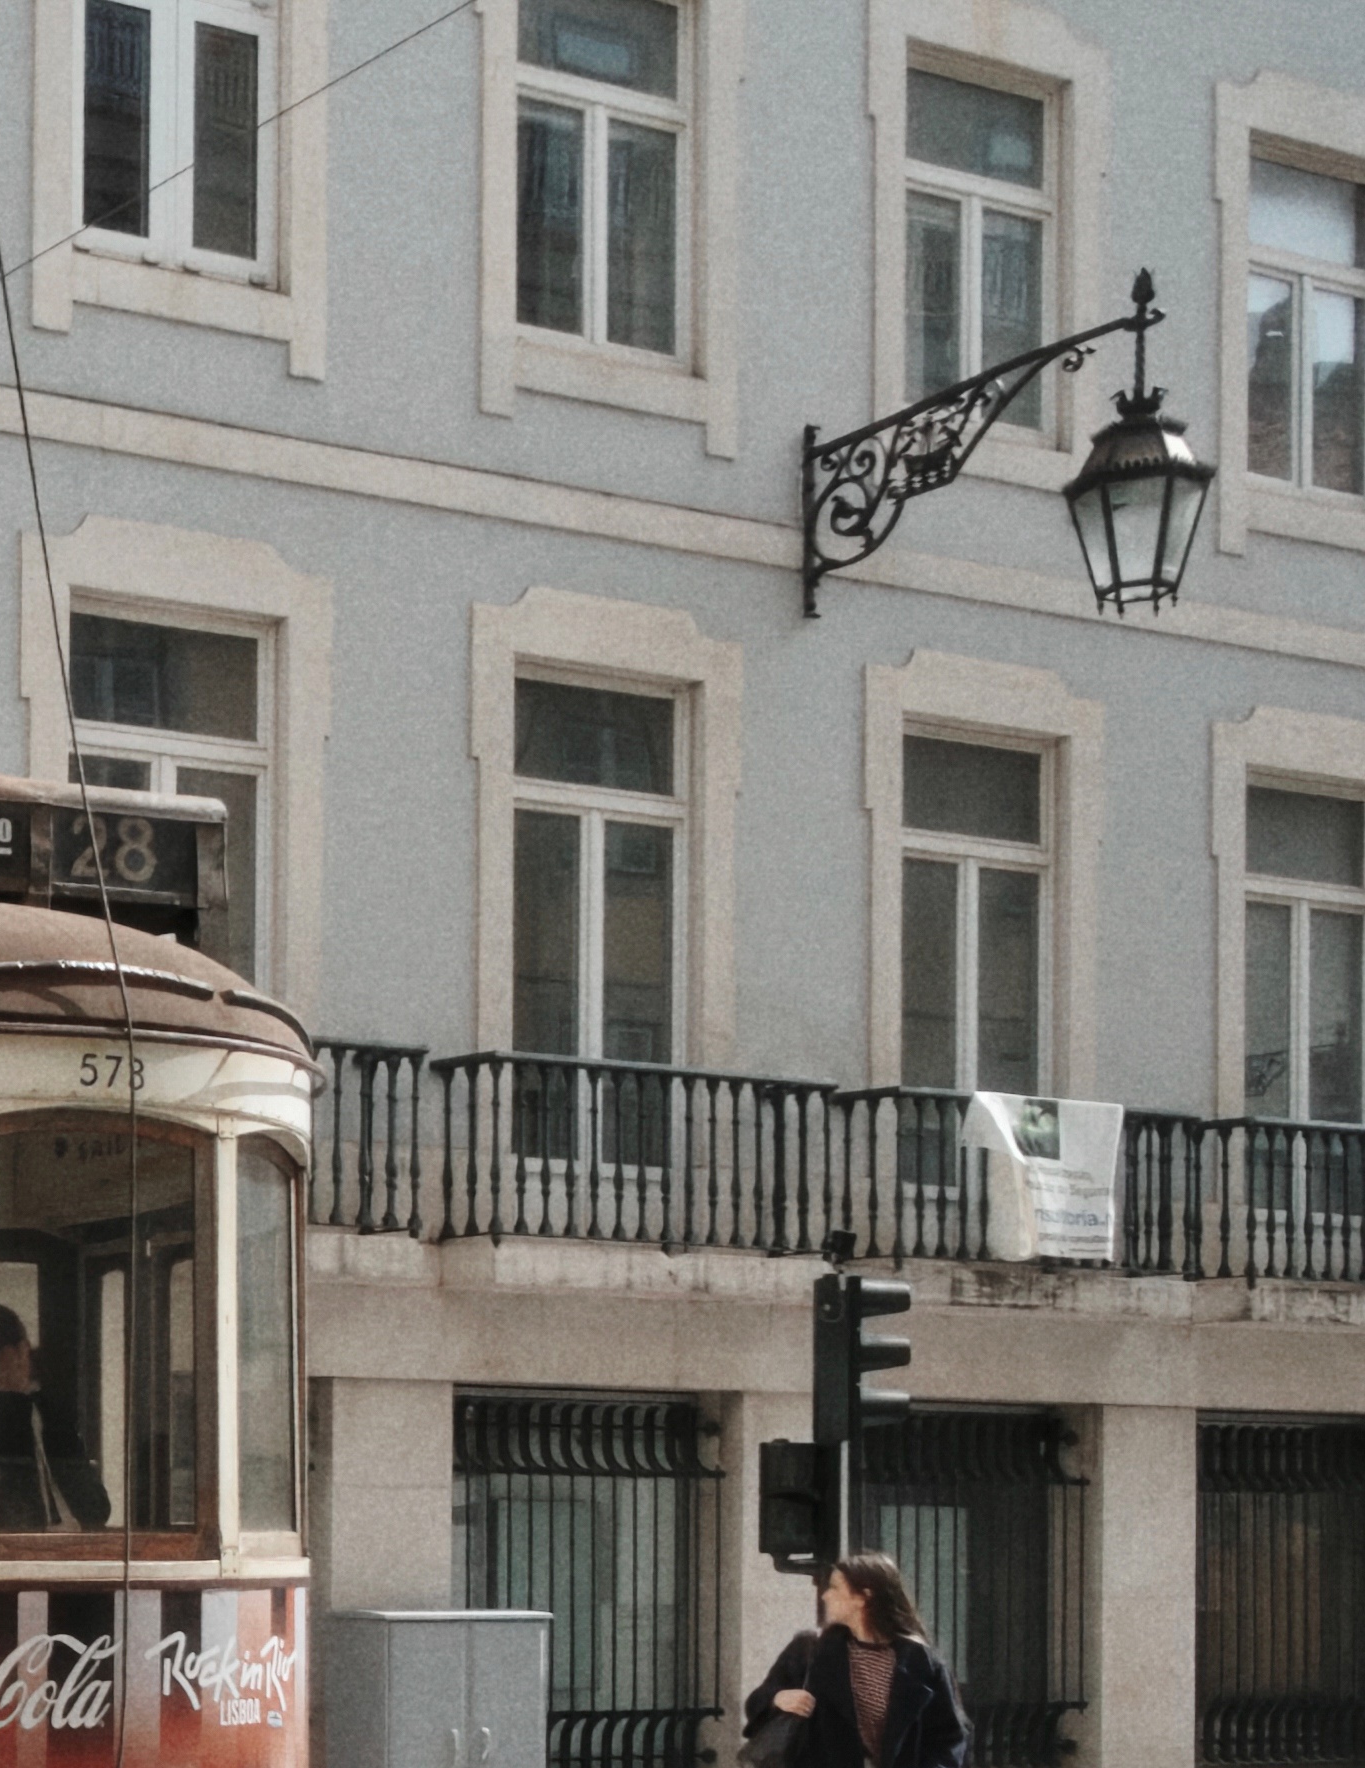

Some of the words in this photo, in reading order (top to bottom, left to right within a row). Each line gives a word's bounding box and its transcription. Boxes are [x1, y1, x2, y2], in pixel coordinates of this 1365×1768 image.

[71, 815, 158, 882] 28
[144, 1631, 240, 1711] Rock
[260, 1635, 297, 1712] Rio
[220, 1698, 261, 1726] LISBOA
